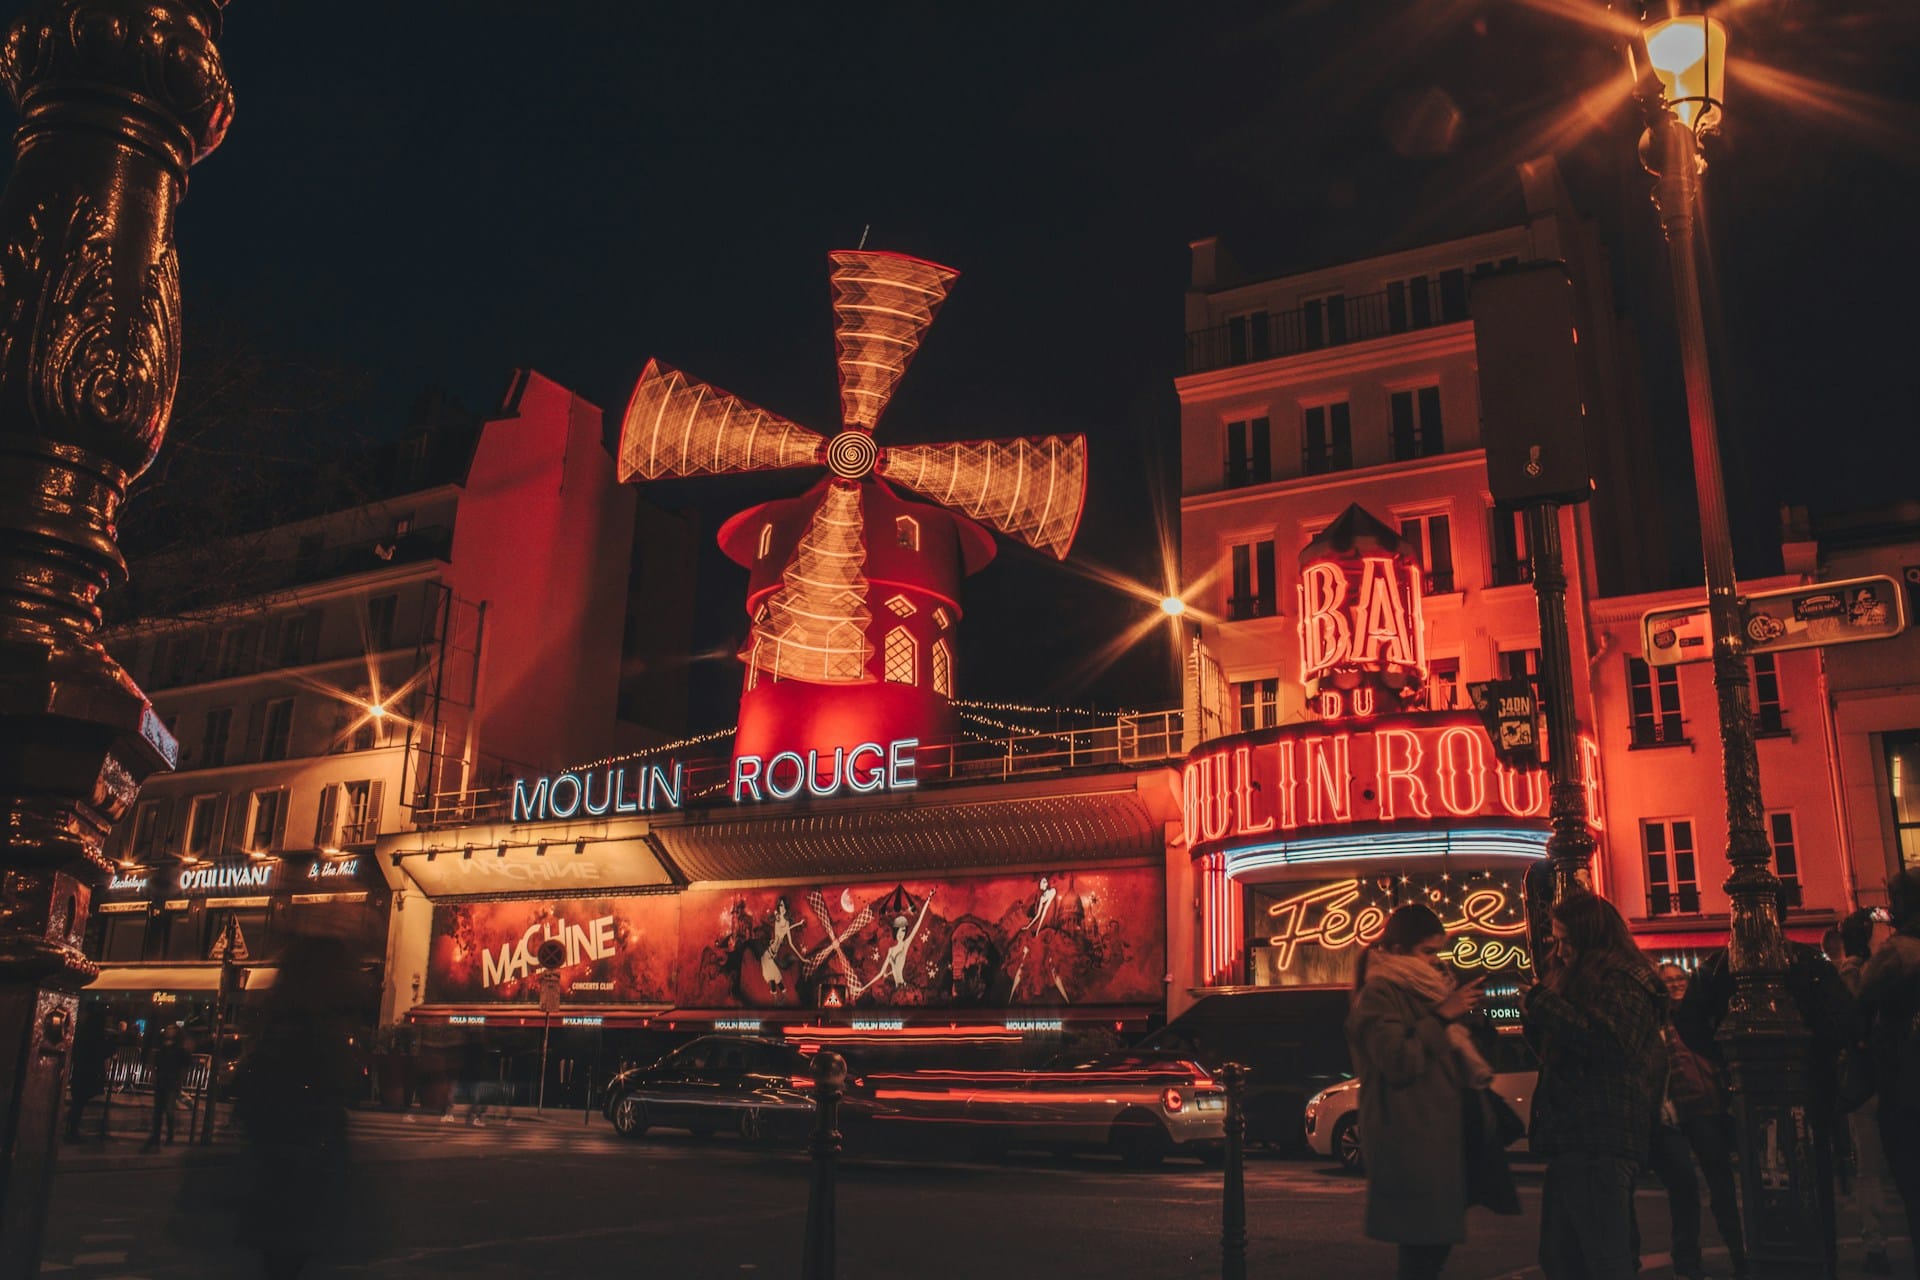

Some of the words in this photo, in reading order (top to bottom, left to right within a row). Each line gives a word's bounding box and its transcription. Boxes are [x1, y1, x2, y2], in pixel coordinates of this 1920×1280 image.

[1322, 689, 1373, 719] DU
[511, 763, 683, 820] MOULIN
[734, 737, 919, 801] ROUGE
[1374, 726, 1603, 831] ROUE
[321, 861, 337, 877] the
[336, 859, 359, 876] Mill
[1269, 879, 1528, 970] Féee
[572, 982, 599, 991] CONCERTS
[599, 982, 614, 991] CLUB
[852, 1020, 878, 1031] MOULIN
[1006, 1020, 1035, 1031] MOULIN
[1035, 1020, 1062, 1031] ROUGE
